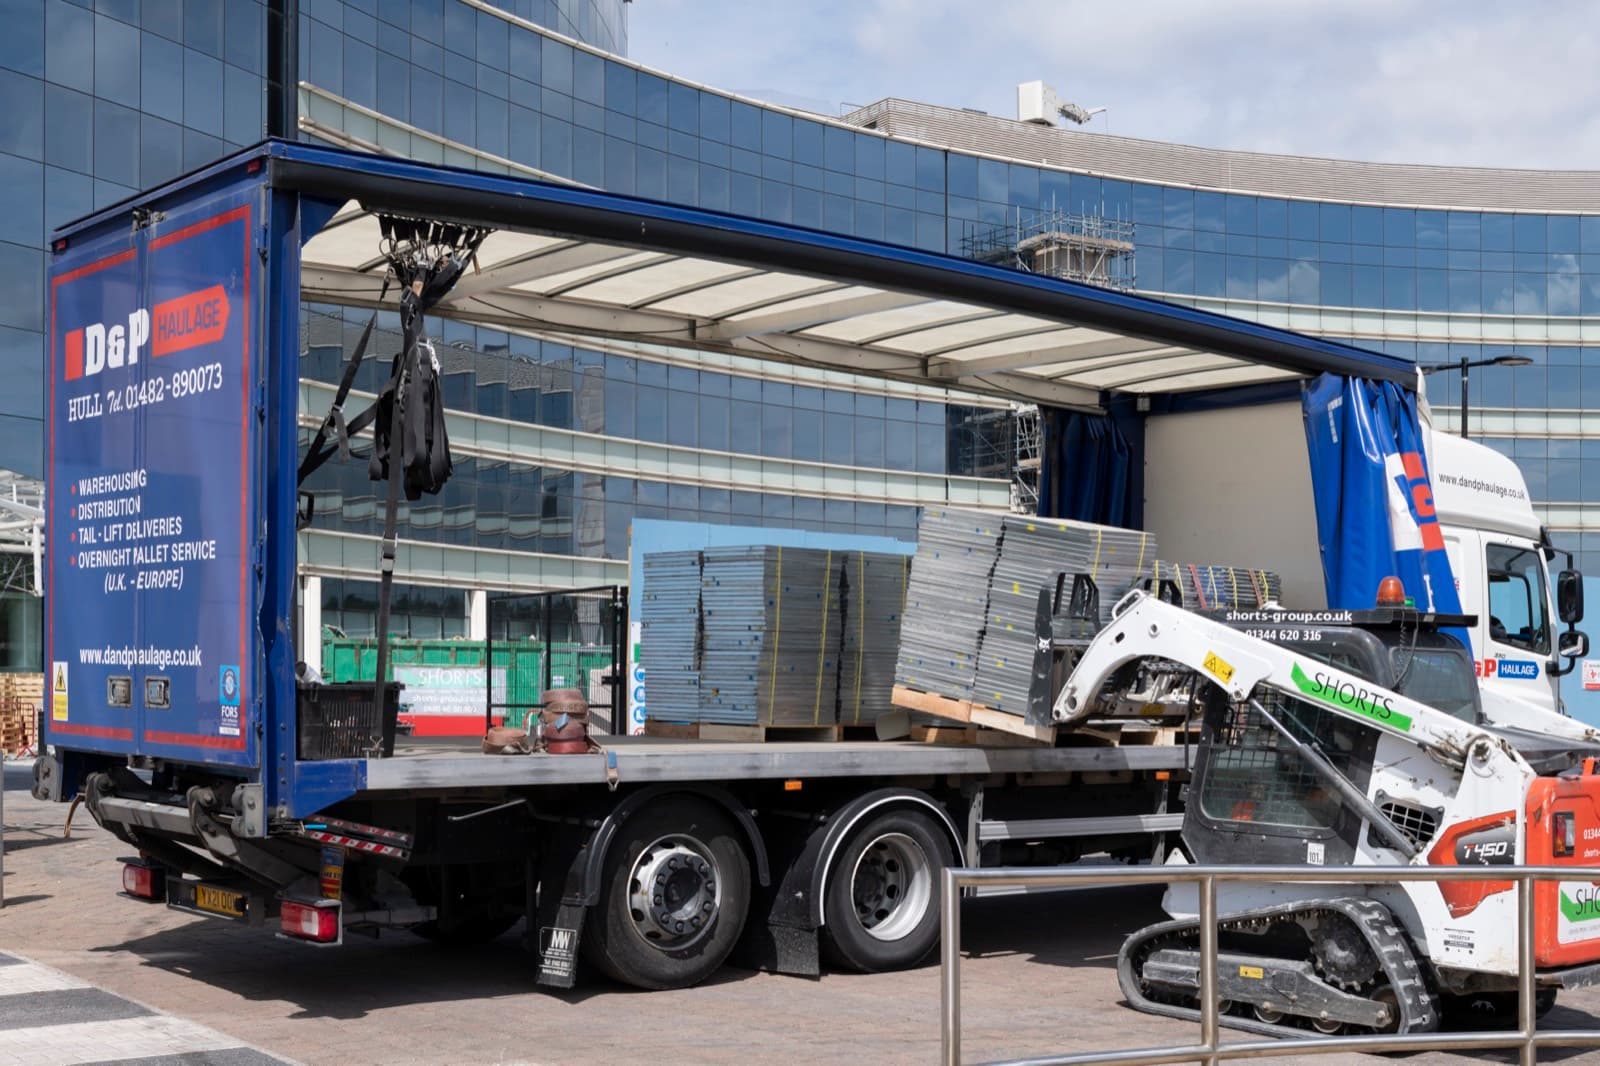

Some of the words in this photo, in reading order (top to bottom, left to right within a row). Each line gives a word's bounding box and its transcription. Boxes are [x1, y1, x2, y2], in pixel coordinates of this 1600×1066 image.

[157, 298, 221, 342] HAULAGE
[85, 308, 149, 376] D&P
[69, 393, 103, 421] HULL
[126, 362, 223, 409] 01482-890073
[79, 468, 147, 496] WAREHOUSING
[1438, 473, 1525, 499] www.dandphaulage.co.uk
[78, 495, 140, 521] DISTRIBUTION
[78, 527, 97, 545] TAIL
[104, 524, 122, 542] LIFT
[126, 516, 182, 541] DELIVERIES
[78, 548, 131, 569] OVERNIGHT
[133, 544, 168, 565] PALLET
[172, 540, 216, 562] SERVICE
[104, 571, 126, 594] (U.K.
[137, 567, 184, 590] EUROPE)
[1226, 609, 1353, 624] shorts-group.co.uk
[1280, 629, 1299, 641] 620
[1302, 629, 1322, 641] 316
[419, 668, 483, 686] SHORTS
[1501, 663, 1536, 676] HAULAGE
[1311, 672, 1394, 720] SHORTS
[221, 705, 238, 719] FORS
[1463, 841, 1508, 859] T450
